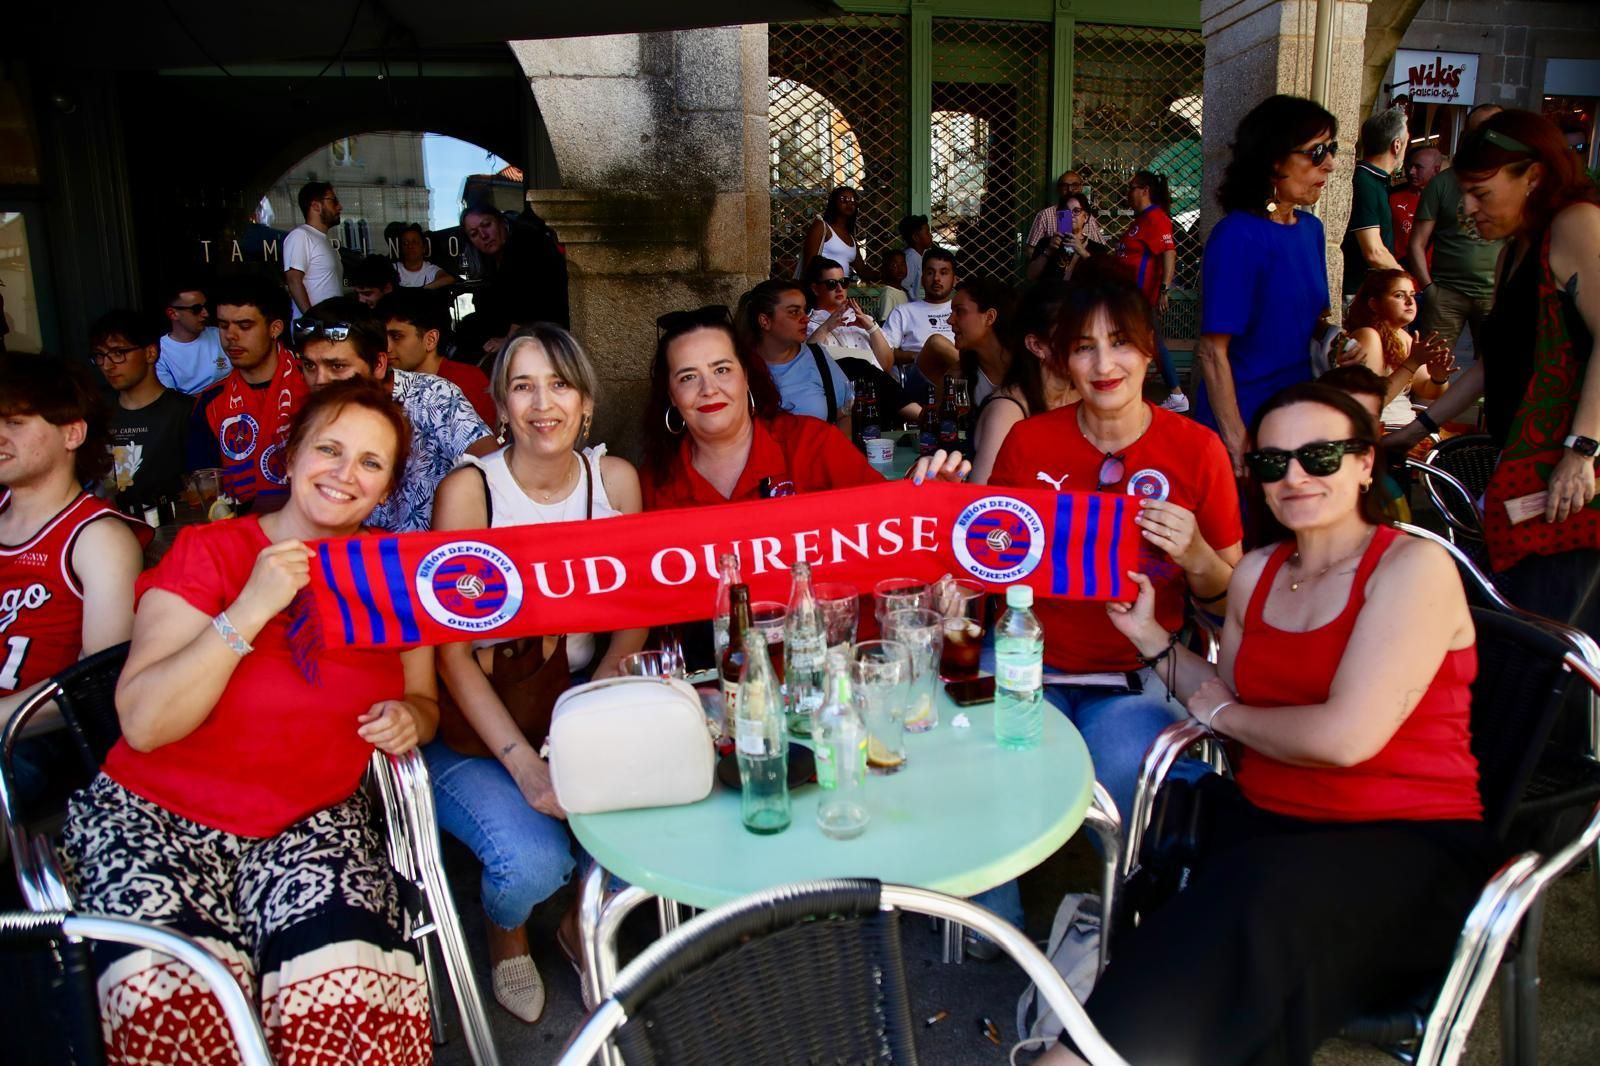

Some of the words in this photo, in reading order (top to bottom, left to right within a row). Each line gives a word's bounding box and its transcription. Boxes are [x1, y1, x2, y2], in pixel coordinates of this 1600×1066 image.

[1408, 56, 1462, 88] Nikis
[958, 502, 987, 527] UNIÓN
[988, 500, 1041, 533] DEPORTIVA
[419, 550, 447, 578] UNIÓN
[447, 545, 512, 573] DEPORTIVA
[530, 555, 627, 599] UD
[650, 516, 939, 586] OURENSE
[970, 565, 1025, 580] OURENSE
[447, 611, 507, 629] OURENSE
